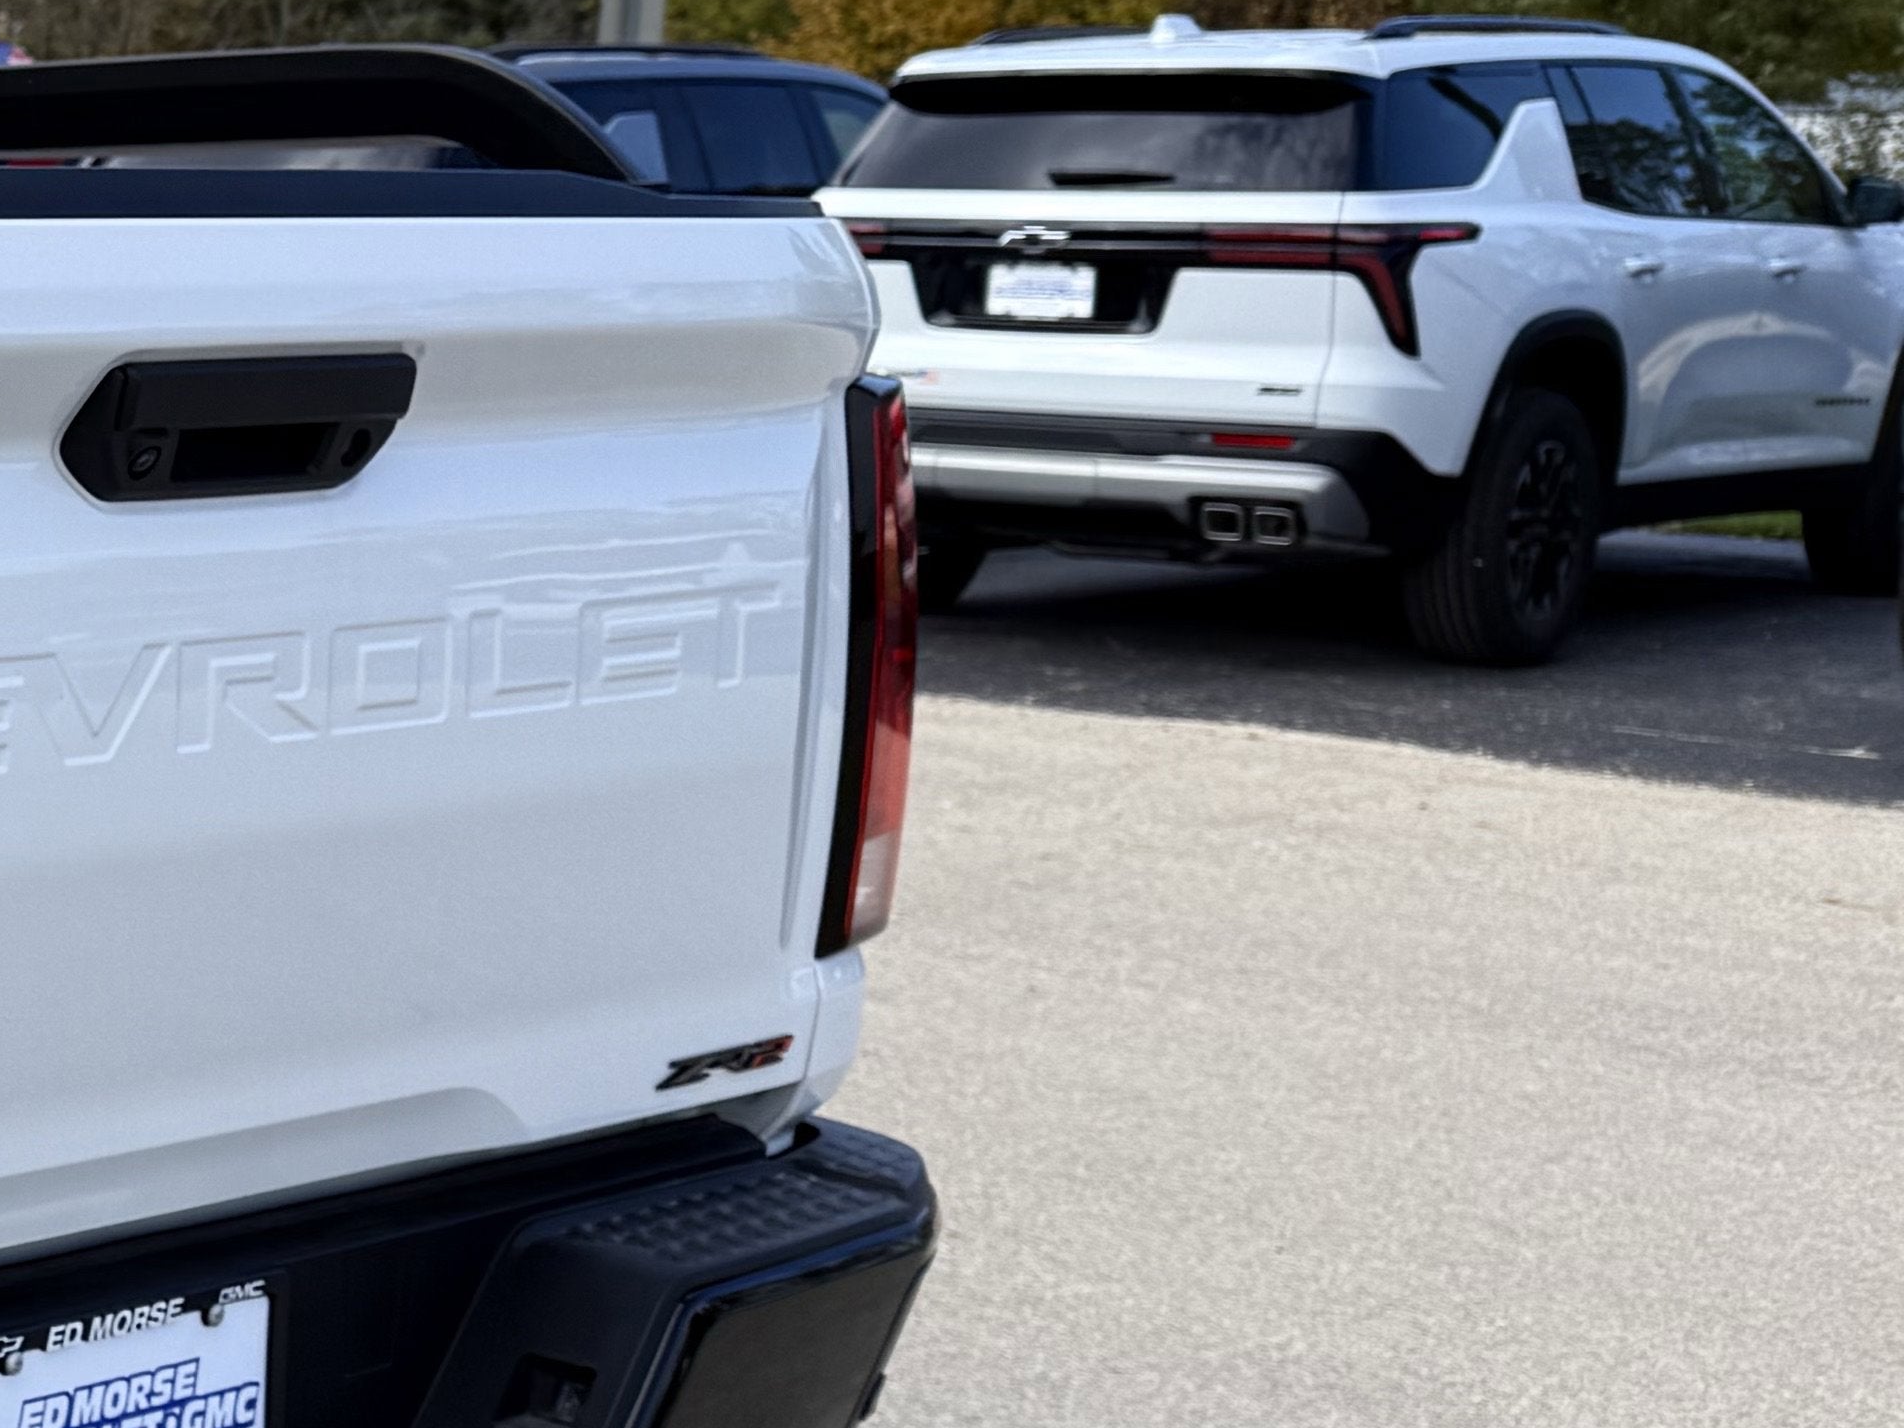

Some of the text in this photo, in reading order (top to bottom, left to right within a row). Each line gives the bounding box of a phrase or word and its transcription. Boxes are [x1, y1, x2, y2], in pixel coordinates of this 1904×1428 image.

[46, 1279, 266, 1352] ED MORSE GMC
[70, 1357, 199, 1427] MORSE
